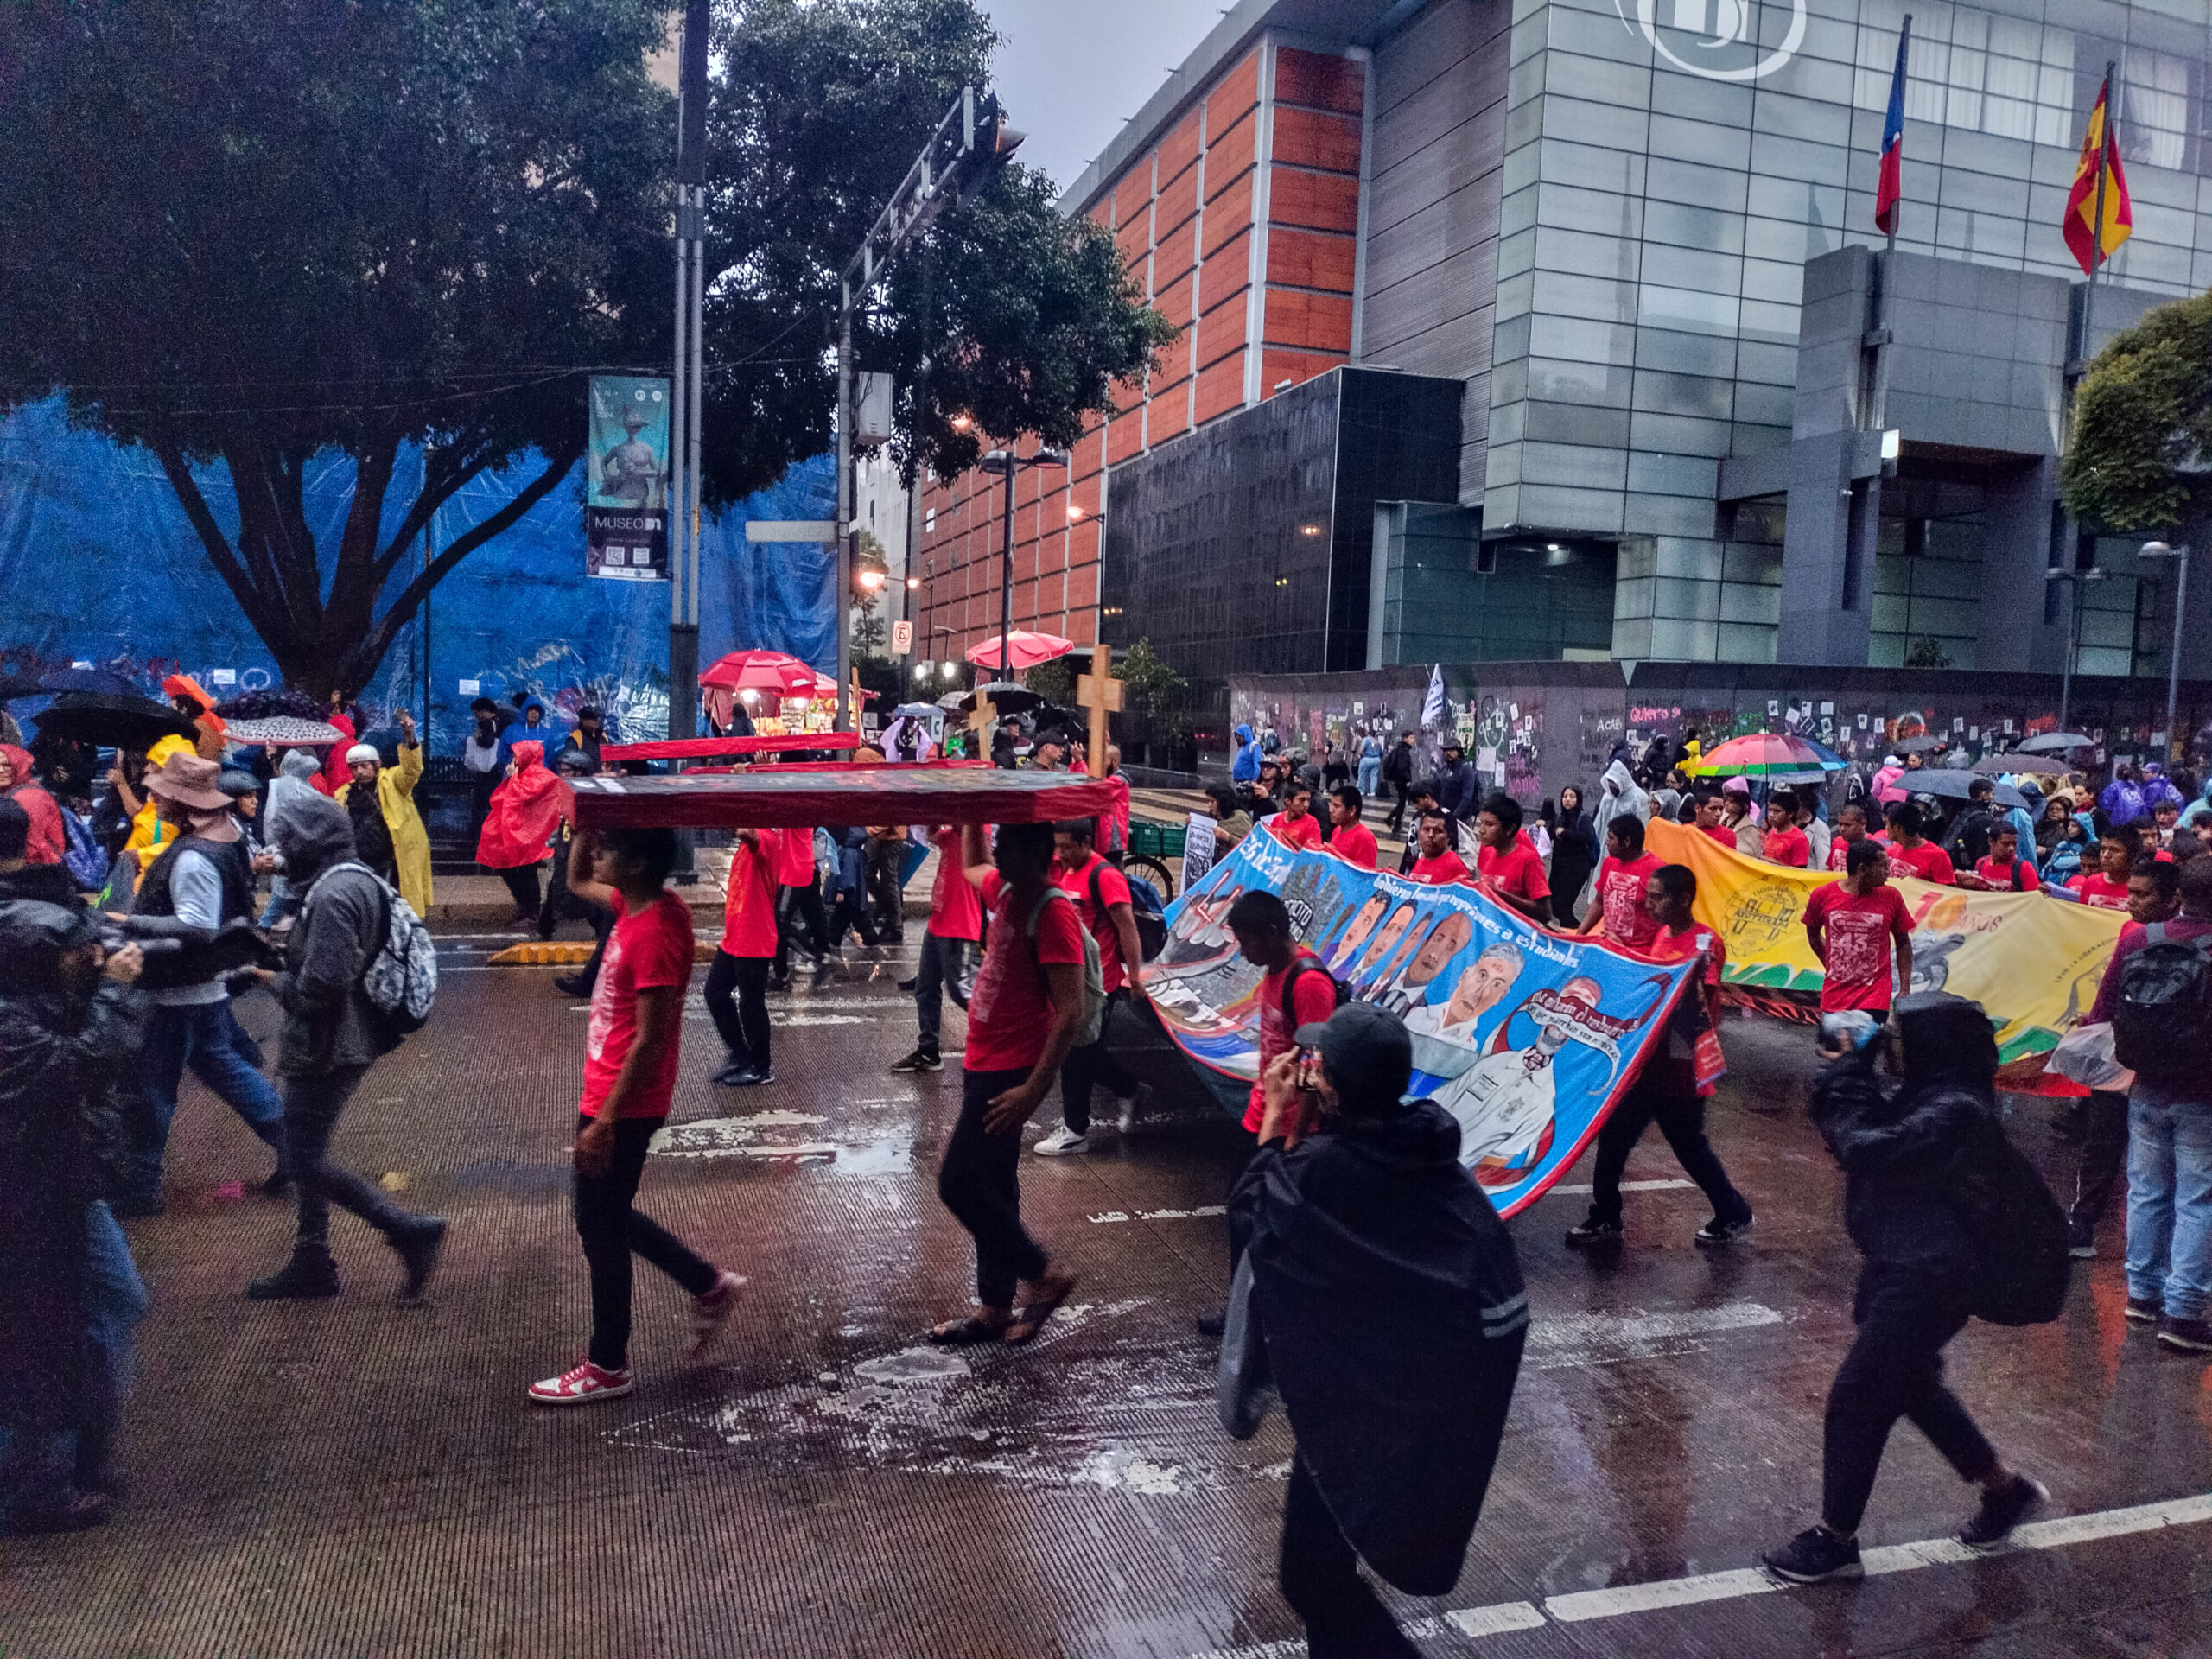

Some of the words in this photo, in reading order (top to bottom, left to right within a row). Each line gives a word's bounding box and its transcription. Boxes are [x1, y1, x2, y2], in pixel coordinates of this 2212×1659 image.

[1597, 718, 1623, 733] ACAB
[1608, 889, 1626, 908] 43
[1501, 929, 1514, 940] a
[1515, 930, 1580, 968] estudiantes
[1837, 932, 1869, 953] 43
